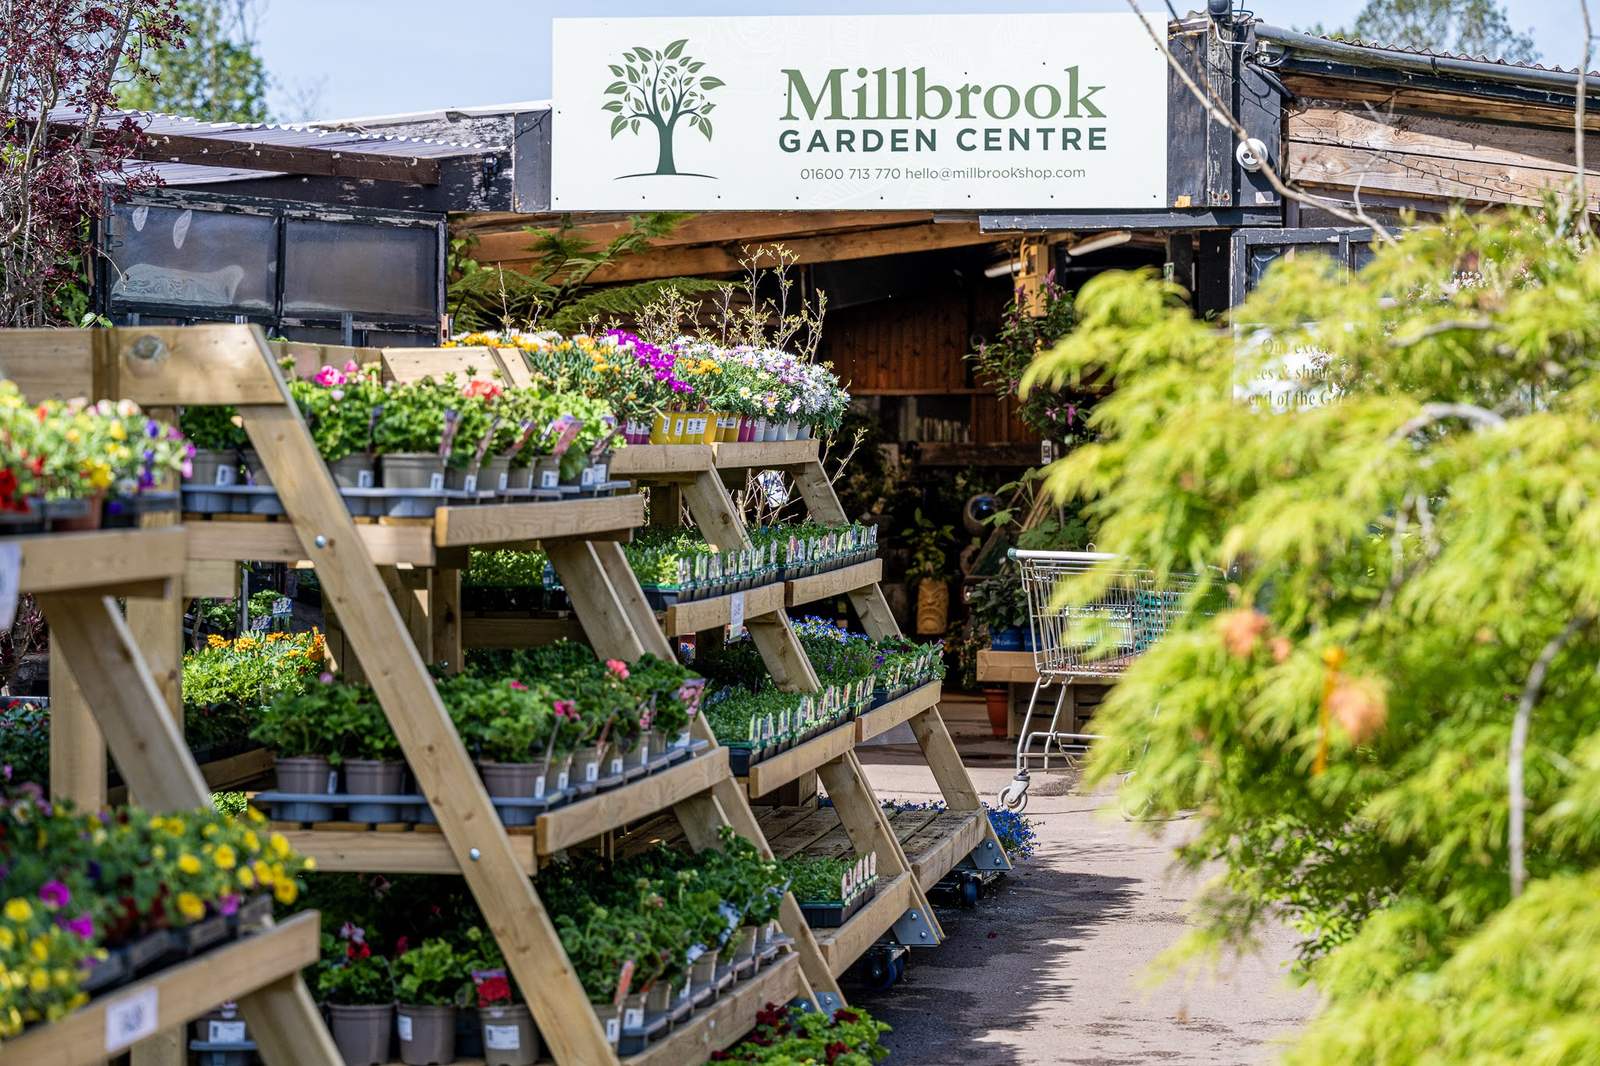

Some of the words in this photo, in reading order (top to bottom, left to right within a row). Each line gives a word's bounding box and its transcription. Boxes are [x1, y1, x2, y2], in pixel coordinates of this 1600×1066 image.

[779, 65, 1107, 121] Millbrook
[778, 128, 937, 153] GARDEN
[956, 127, 1107, 151] CENTRE
[800, 167, 844, 181] 01600
[849, 167, 870, 180] 713
[875, 167, 900, 180] 770
[905, 166, 1086, 181] hello@millbrookshop.com
